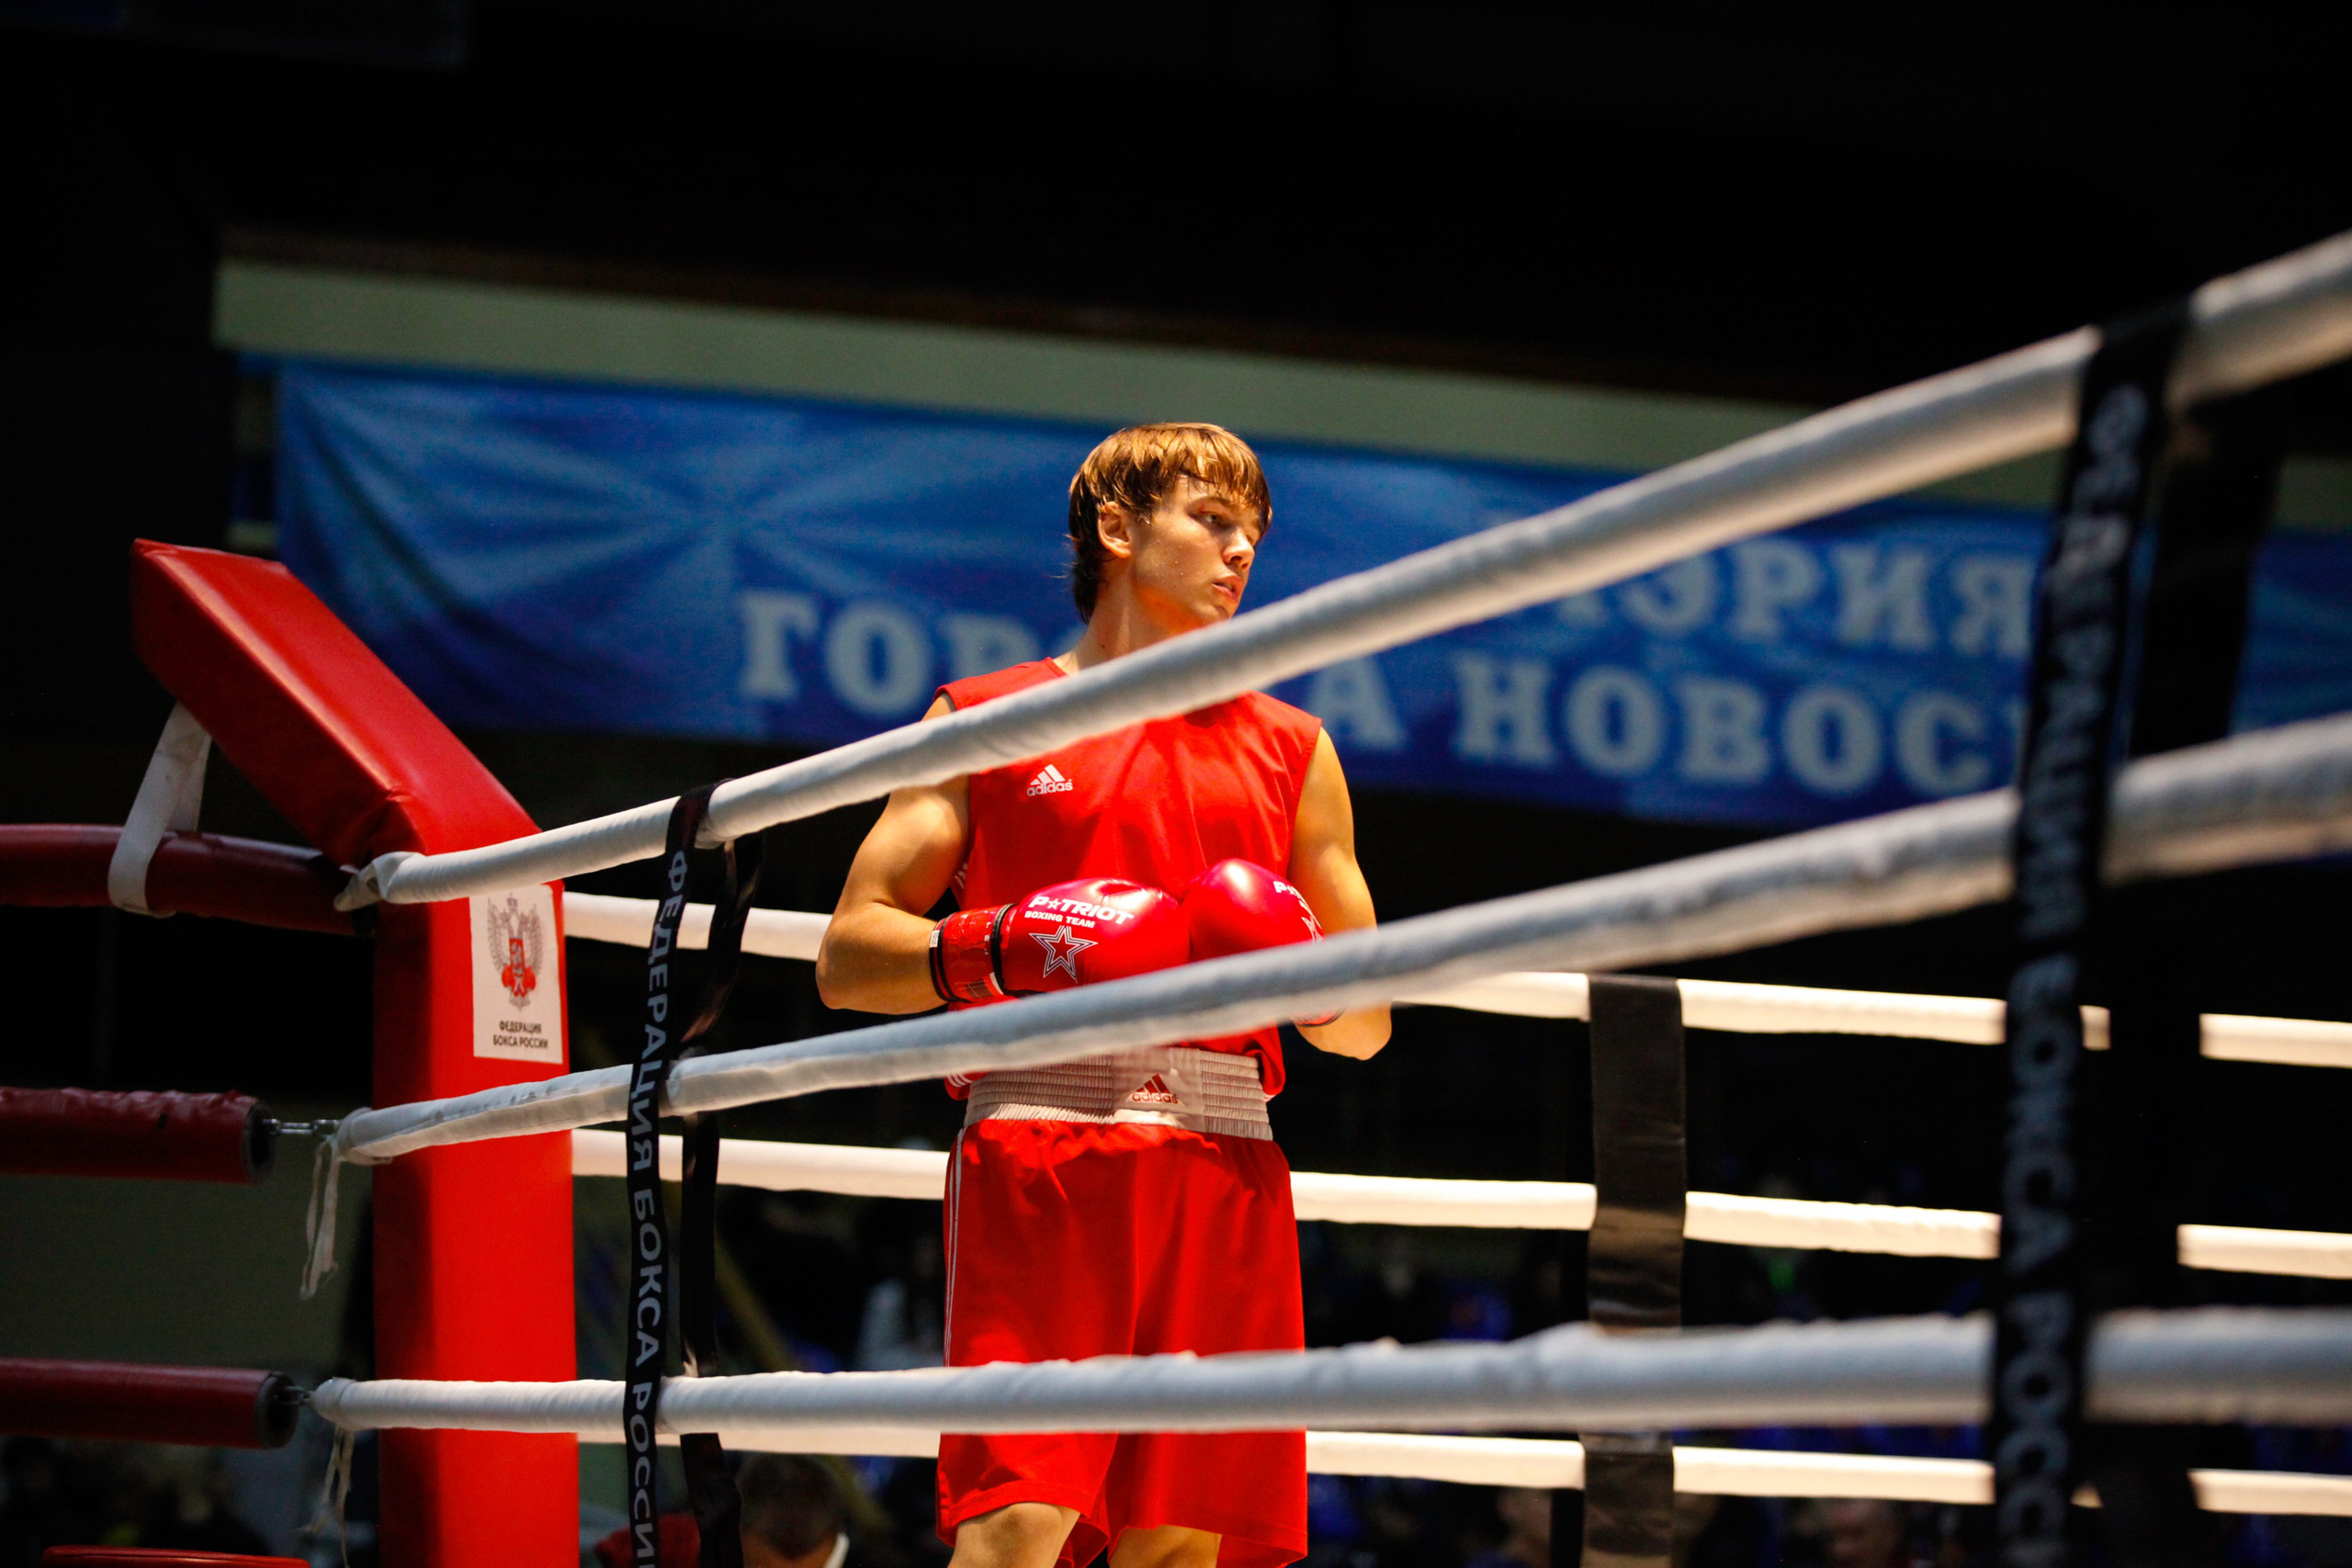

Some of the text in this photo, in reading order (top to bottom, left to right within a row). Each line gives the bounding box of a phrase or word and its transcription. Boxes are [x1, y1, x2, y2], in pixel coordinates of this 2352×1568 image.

[1559, 540, 2030, 658] ЭРИЯ
[741, 589, 2028, 797] ГОРА НОВОС
[1026, 780, 1073, 796] adidas
[1024, 910, 1096, 929] BOXING TEAM
[499, 1020, 542, 1034] ФЕДЕРАЦИЯ
[492, 1034, 548, 1049] БОКСА РОССИИ
[1132, 1092, 1179, 1104] adidas
[629, 850, 689, 1568] ФЕДЕРАЦИЯ БОКСА РОССИ
